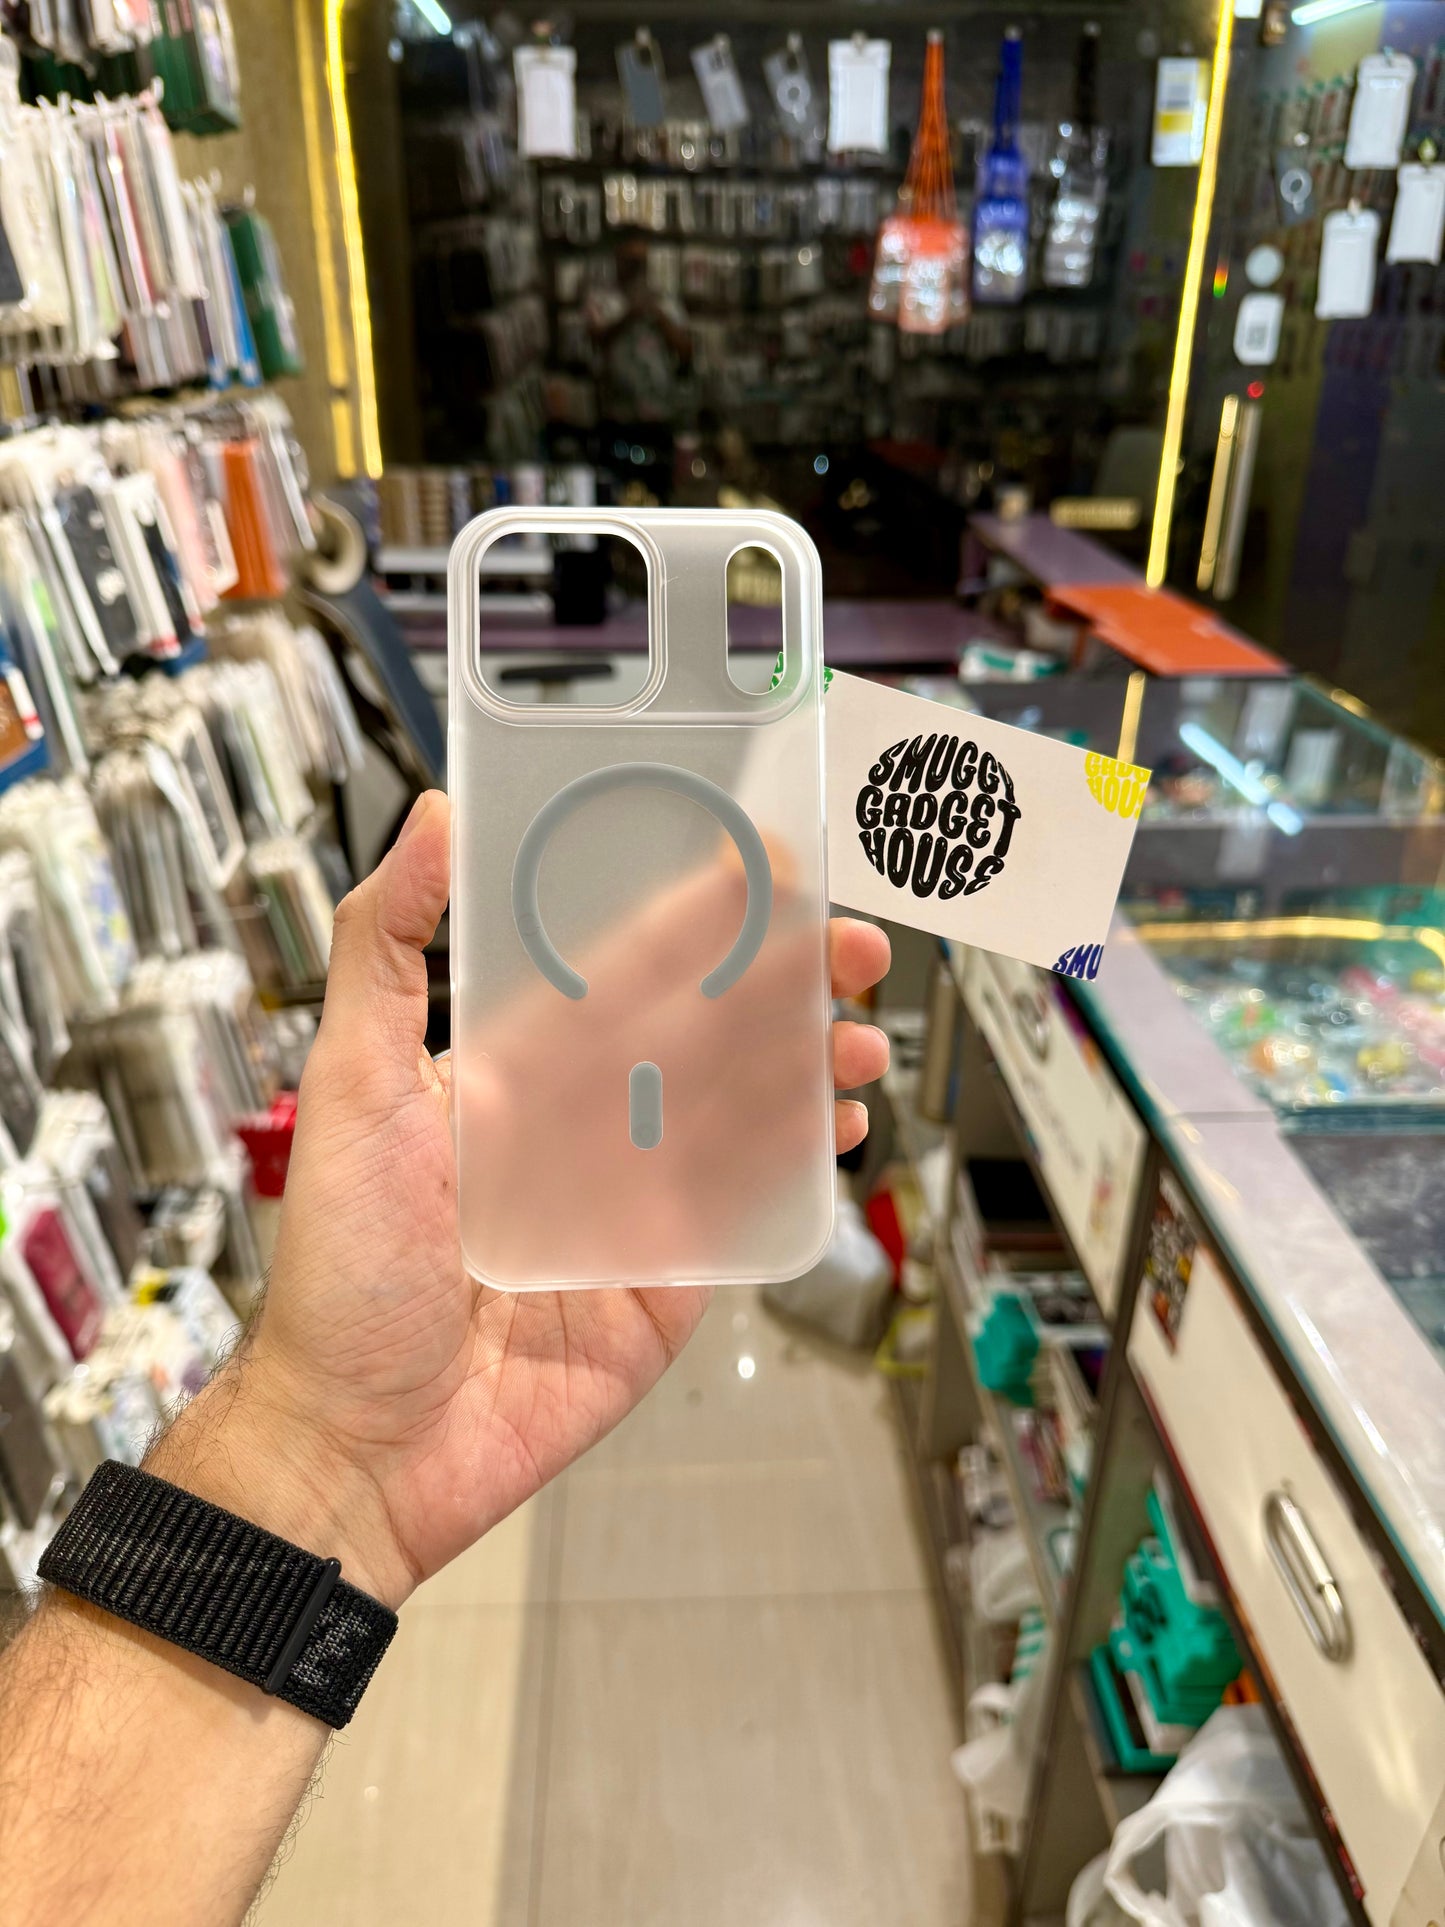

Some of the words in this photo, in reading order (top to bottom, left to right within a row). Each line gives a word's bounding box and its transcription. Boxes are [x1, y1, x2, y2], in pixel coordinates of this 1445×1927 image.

[868, 733, 1015, 803] SMUGGY
[856, 784, 1021, 858] GADGET
[859, 827, 1005, 900] HOUSE
